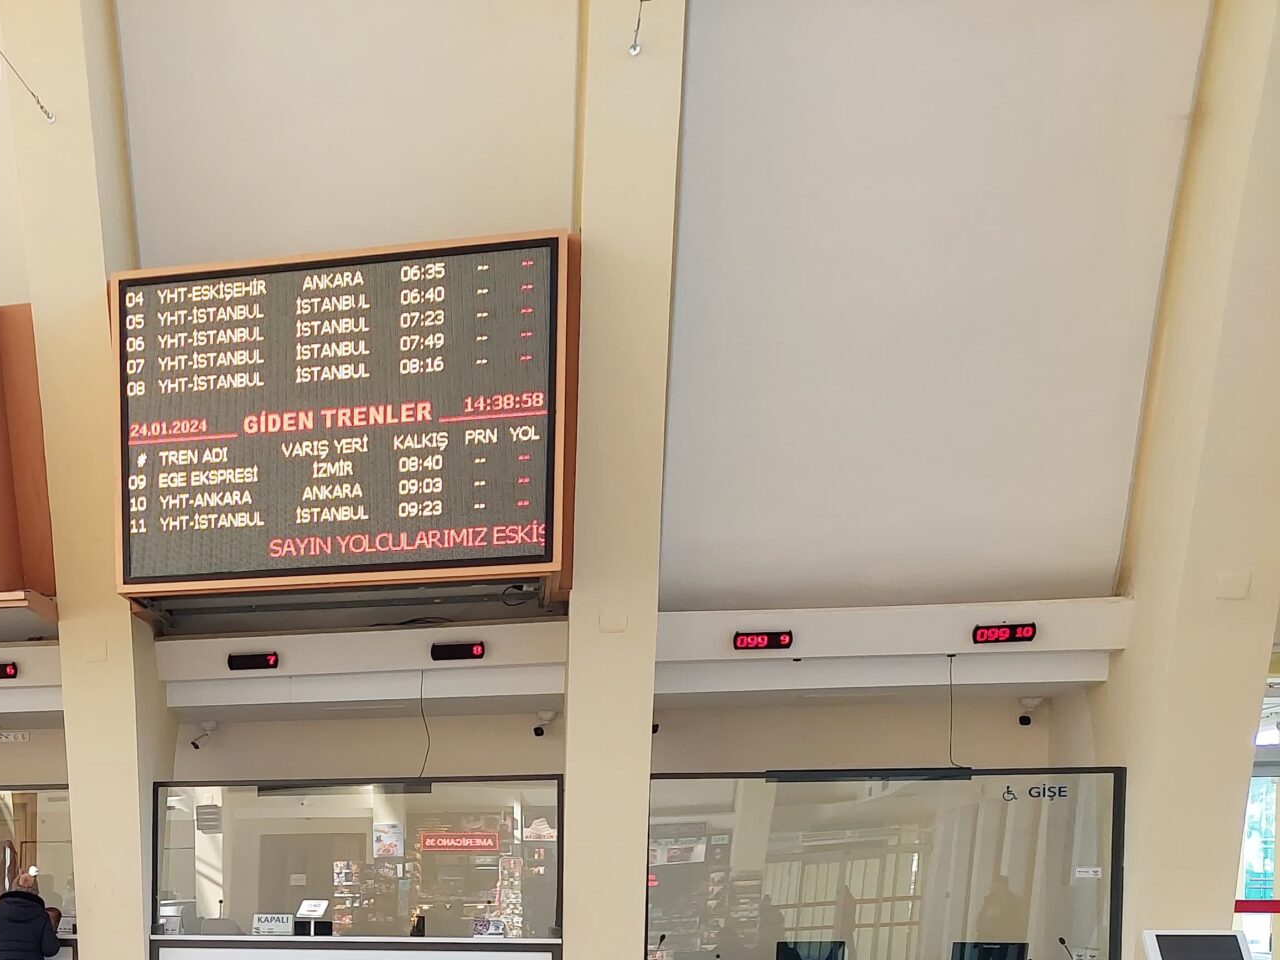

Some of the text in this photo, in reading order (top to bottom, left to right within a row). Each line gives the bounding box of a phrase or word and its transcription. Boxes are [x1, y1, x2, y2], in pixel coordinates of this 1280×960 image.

[126, 262, 445, 307] 04 YHT-ESKİŞEHİR ANKARA 06:35
[126, 286, 445, 330] 05 YHT-İSTANBUL İSTANBUL 06:40
[126, 310, 444, 352] 06 YHT-İSTANBUL İSTANBUL 07:23
[127, 333, 444, 374] 07 YHT-İSTANBUL İSTANBUL 07:49
[127, 356, 444, 396] 08 YHT-İSTANBUL İSTANBUL 08:16
[130, 392, 544, 437] 24.01.2024 GİDEN TRENLER 14:38:58
[159, 449, 198, 466] TREN
[202, 447, 228, 464] ADI
[282, 440, 329, 460] VARIŞ
[334, 434, 368, 454] YERİ
[393, 432, 448, 450] KALKIŞ
[465, 428, 497, 444] PRN
[510, 426, 540, 441] YOL
[128, 455, 443, 490] 09 EGE EKSPRESİ İZMİR 08:40
[130, 478, 442, 511] 10 YHT-ANKARA ANKARA 09:03
[130, 501, 442, 534] 11 YHT-İSTANBUL İSTANBUL 09:23
[270, 535, 331, 557] SAYIN
[336, 527, 487, 554] YOLCULARIMIZ
[472, 645, 482, 655] 8
[736, 635, 790, 647] 099 9
[976, 626, 1033, 642] 099 10
[6, 666, 14, 676] 6
[267, 655, 276, 665] 7
[1028, 784, 1068, 801] GİŞE
[257, 916, 289, 924] KAPALI
